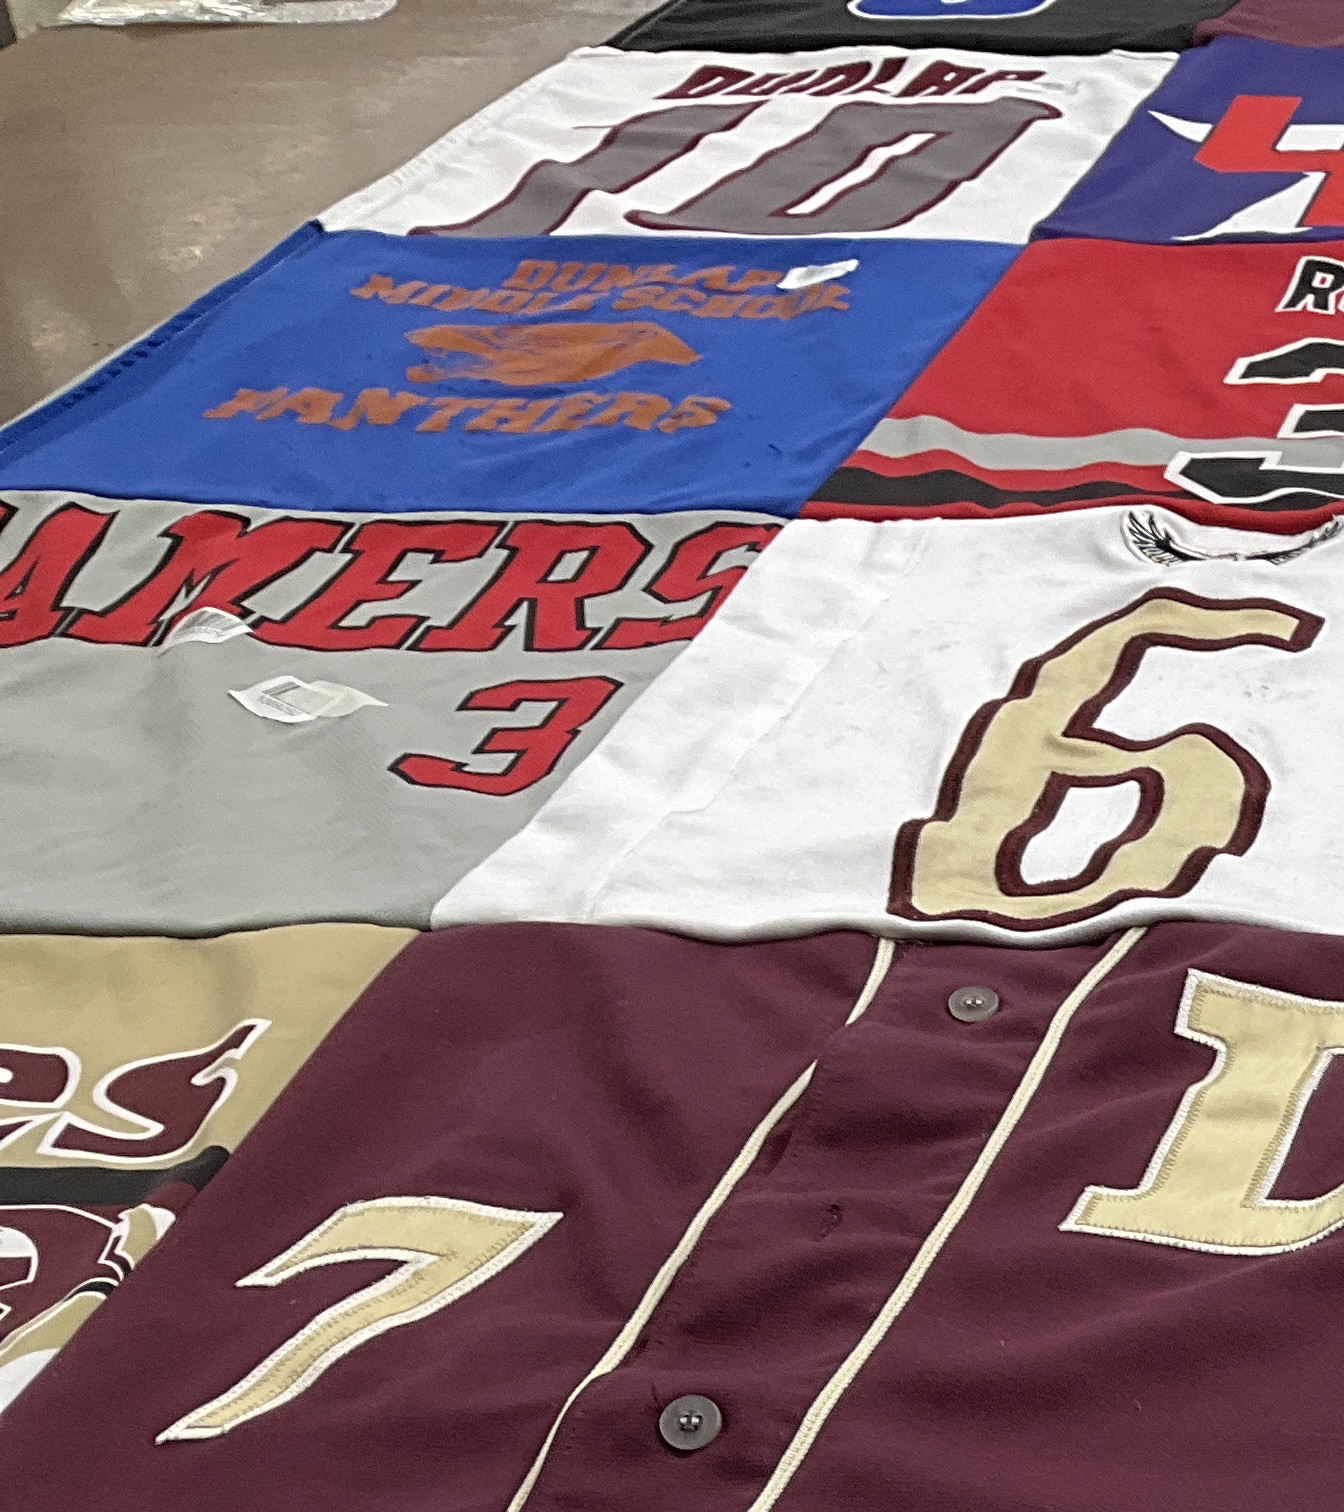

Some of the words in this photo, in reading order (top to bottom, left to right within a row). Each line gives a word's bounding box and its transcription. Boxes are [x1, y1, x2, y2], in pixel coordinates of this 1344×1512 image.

[652, 56, 1047, 99] DUNLAP
[406, 99, 1064, 235] 10
[502, 259, 787, 293] DUNLAP
[203, 387, 732, 434] PANTHERS
[0, 497, 784, 652] AMERS
[388, 676, 625, 797] 3
[887, 586, 1326, 933] 6
[154, 1195, 565, 1447] 7
